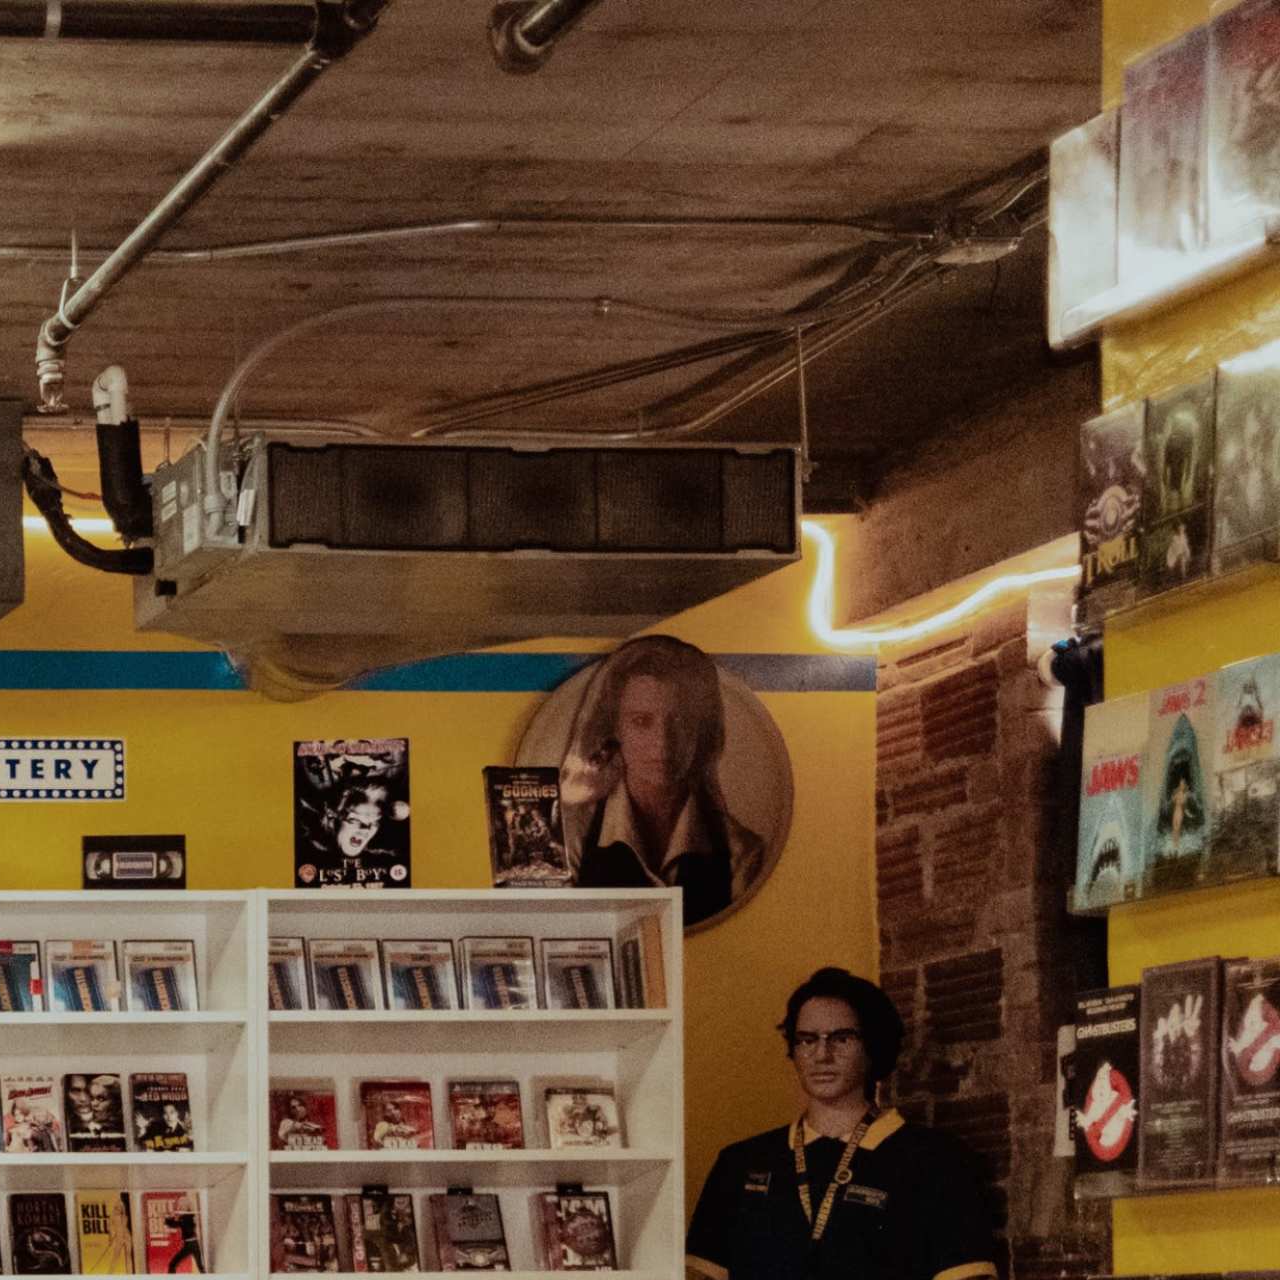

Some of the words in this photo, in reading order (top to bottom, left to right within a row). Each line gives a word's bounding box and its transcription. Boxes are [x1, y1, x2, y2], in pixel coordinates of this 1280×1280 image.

[1083, 536, 1137, 584] TROLL
[1193, 680, 1207, 707] 2
[1086, 754, 1139, 797] JAWS
[502, 784, 558, 798] GOONIES
[74, 968, 94, 1012] CKBUSTER
[81, 1204, 110, 1220] KILL
[82, 1220, 110, 1235] BILL
